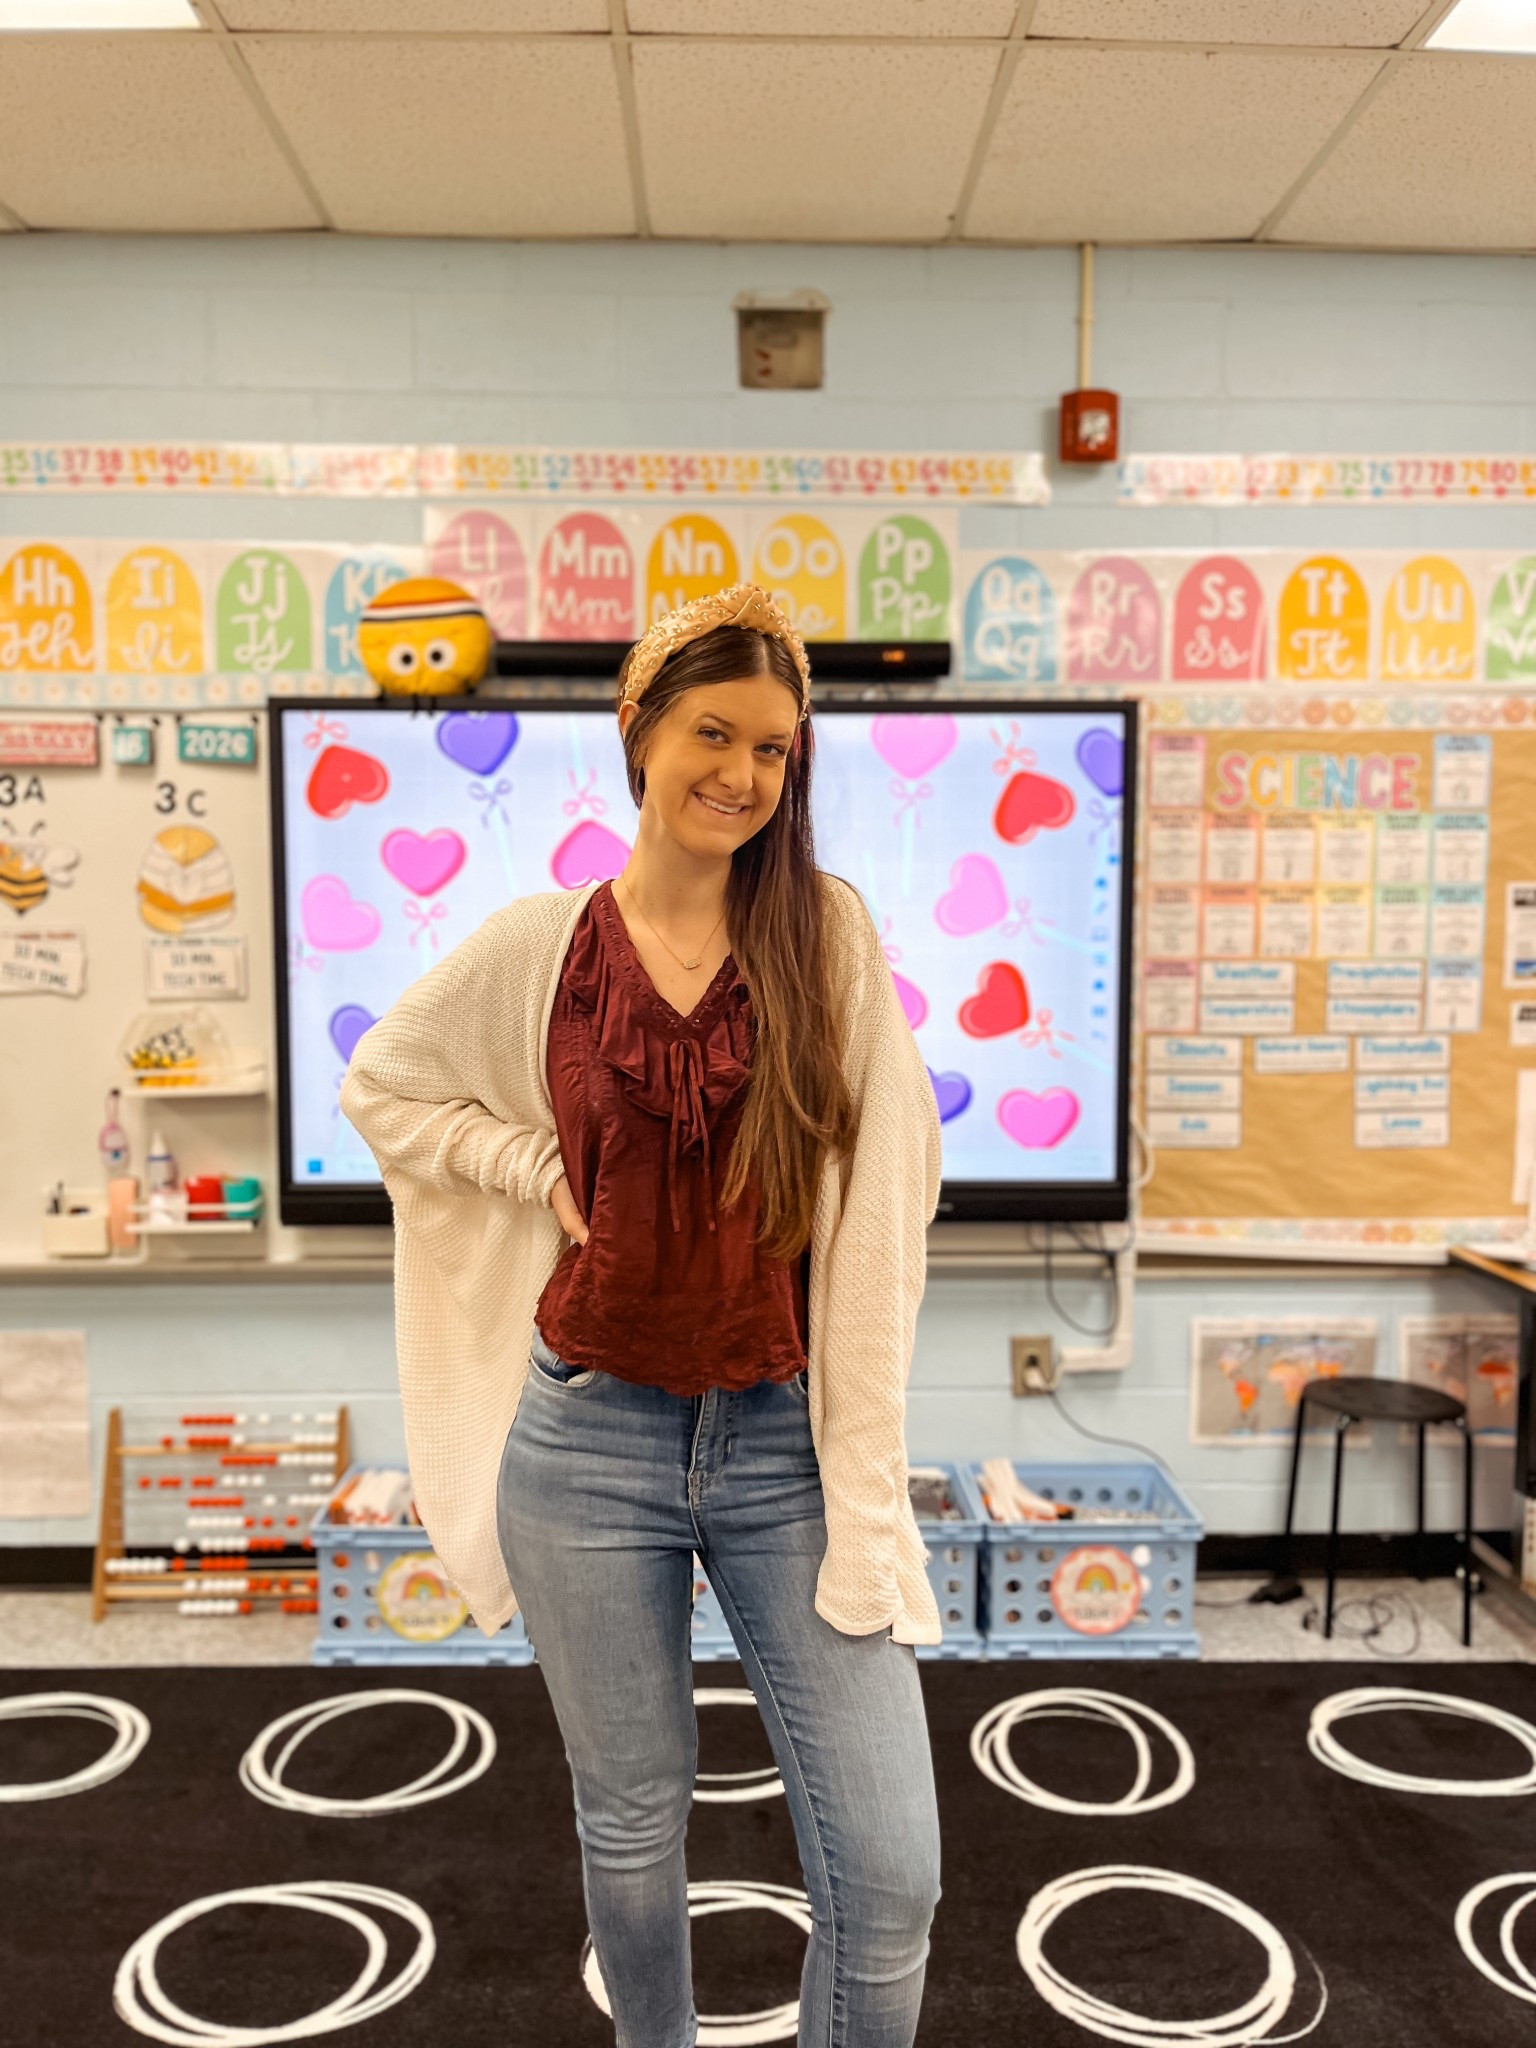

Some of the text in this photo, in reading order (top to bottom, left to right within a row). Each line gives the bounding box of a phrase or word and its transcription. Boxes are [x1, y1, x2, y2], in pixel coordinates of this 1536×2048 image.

[3, 448, 28, 473] 35
[33, 448, 58, 472] 36
[63, 448, 89, 472] 37
[97, 448, 122, 473] 38
[130, 448, 157, 473] 39
[161, 448, 191, 473] 40
[193, 449, 218, 475] 41
[514, 454, 537, 478] 51
[544, 454, 569, 478] 52
[574, 454, 600, 478] 53
[606, 455, 635, 479] 54
[639, 455, 667, 479] 55
[669, 455, 696, 479] 56
[700, 456, 727, 480] 57
[734, 456, 758, 480] 58
[765, 457, 794, 481] 59
[795, 457, 823, 480] 60
[825, 457, 849, 480] 61
[857, 457, 884, 481] 62
[890, 457, 916, 481] 63
[919, 457, 949, 482] 64
[951, 458, 978, 482] 65
[983, 458, 1012, 482] 66
[1339, 460, 1364, 484] 75
[1369, 460, 1393, 484] 76
[1398, 460, 1424, 483] 77
[1428, 460, 1454, 483] 78
[1461, 459, 1487, 483] 79
[1490, 460, 1517, 484] 80
[548, 528, 629, 579] Mm
[661, 525, 724, 577] Nn
[759, 526, 840, 579] Oo
[876, 523, 933, 586] Pp
[13, 555, 75, 608] Hh
[130, 556, 177, 608] Ii
[236, 556, 288, 623] Jj
[543, 587, 634, 625] Mm
[870, 576, 944, 639] Pp
[981, 564, 1042, 625] Qq
[1091, 570, 1142, 619] Rr
[1199, 571, 1248, 621] Ss
[1301, 567, 1348, 618] Tt
[1396, 571, 1464, 624] Uu
[183, 729, 249, 758] 2026
[1217, 755, 1418, 811] SCIENCE
